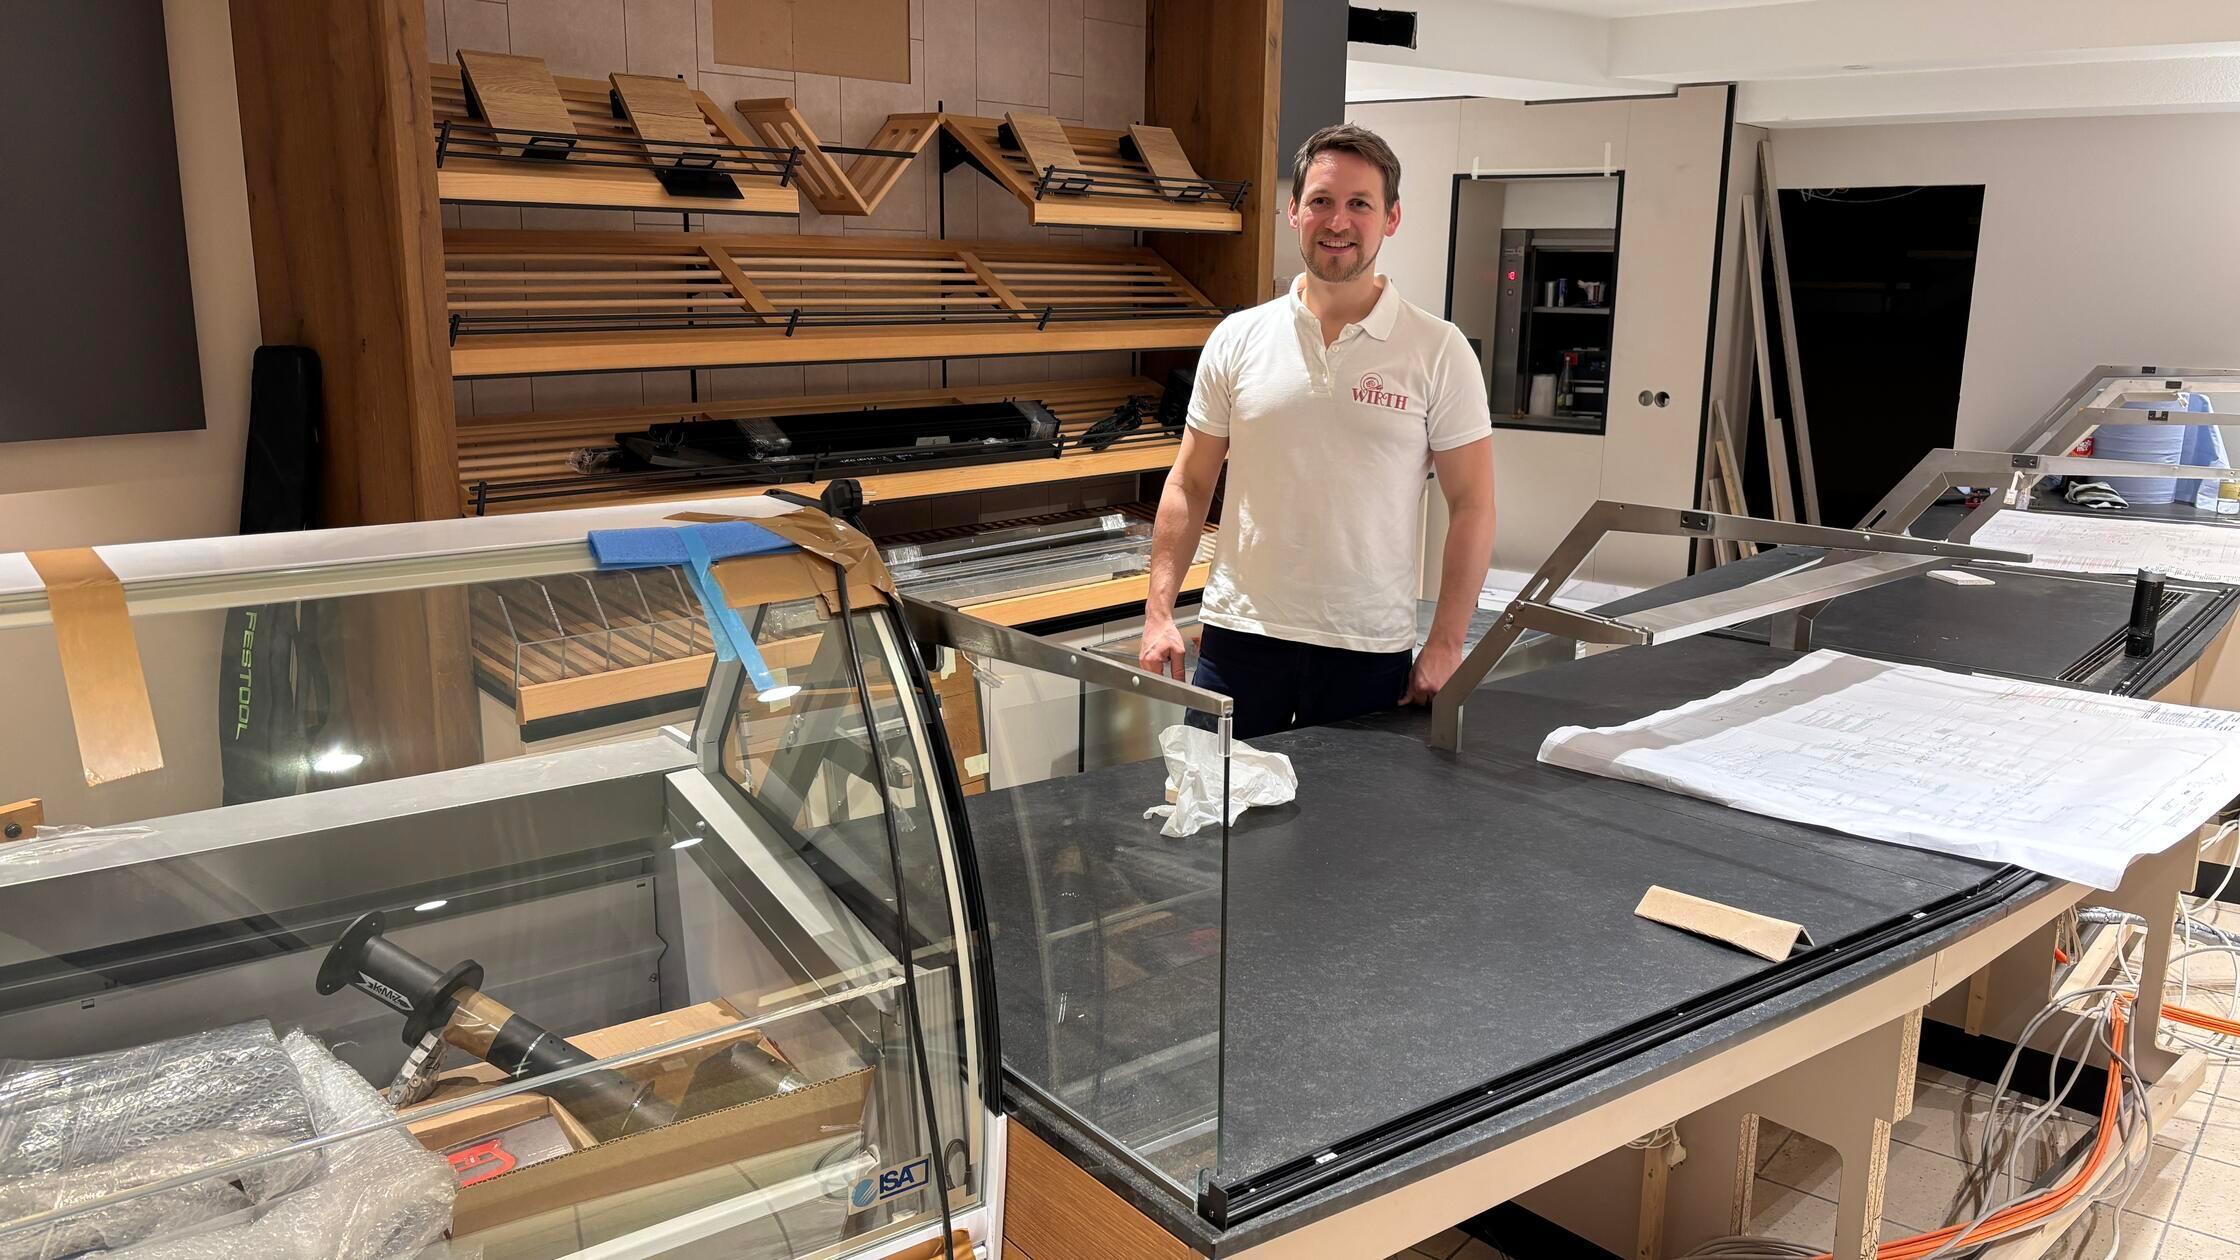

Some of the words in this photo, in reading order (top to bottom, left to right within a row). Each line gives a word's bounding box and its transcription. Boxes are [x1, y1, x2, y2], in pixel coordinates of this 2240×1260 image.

[1352, 387, 1409, 410] WIRTH
[235, 611, 257, 741] FESTOOL
[879, 1166, 915, 1194] ISA
